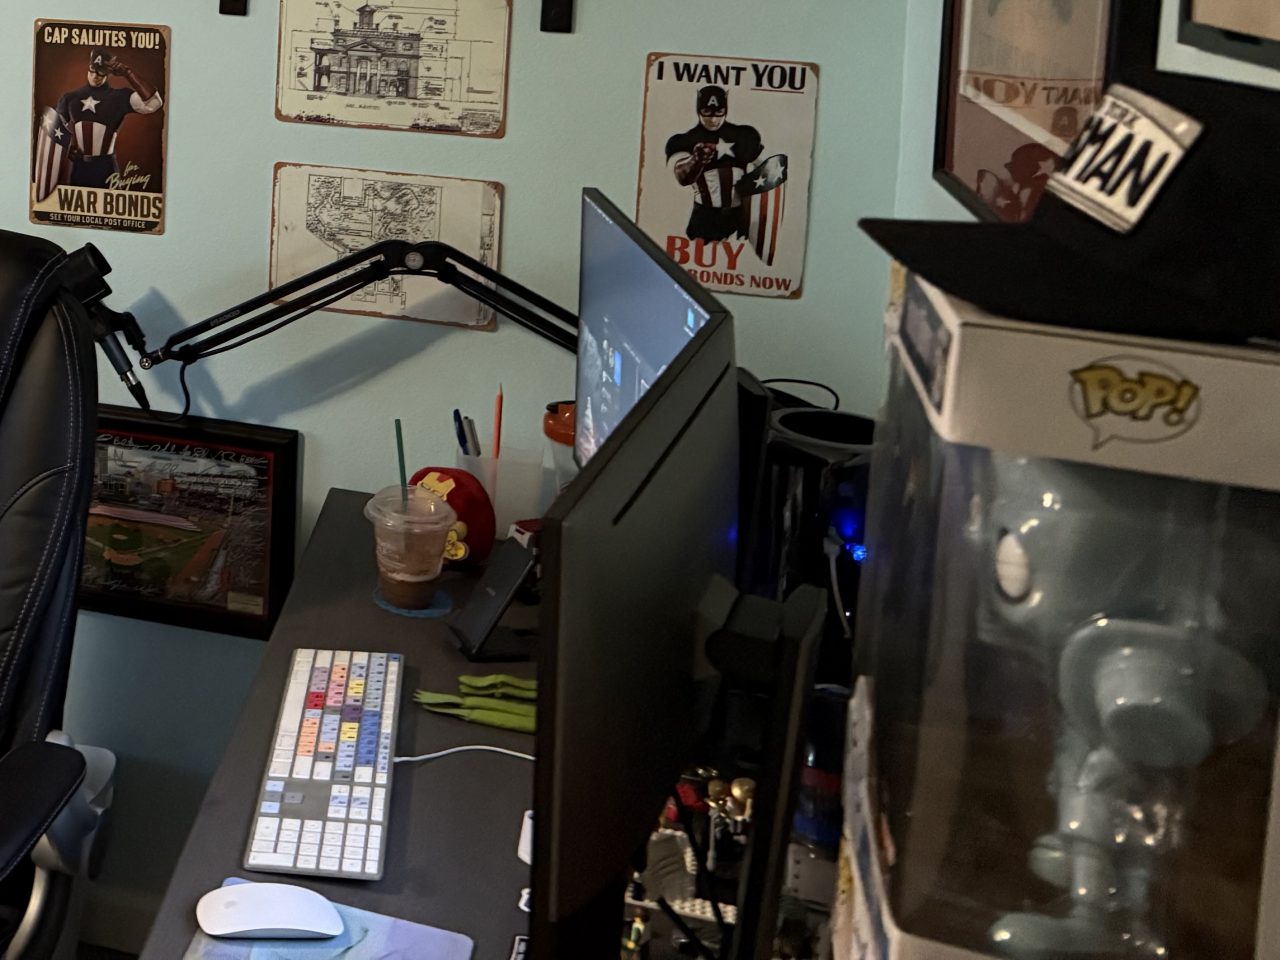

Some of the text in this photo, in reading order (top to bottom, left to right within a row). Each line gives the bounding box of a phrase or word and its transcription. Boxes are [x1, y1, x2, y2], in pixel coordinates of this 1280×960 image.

[44, 26, 160, 49] CAP SALUTES YOU!
[94, 56, 102, 66] A
[656, 61, 806, 90] I WANT YOU
[707, 95, 719, 106] A
[124, 160, 140, 175] for
[106, 172, 152, 190] Buying
[58, 188, 162, 219] WAR BONDS
[64, 214, 81, 224] YOUR
[82, 216, 102, 225] LOCAL
[104, 218, 122, 226] POST
[122, 219, 146, 228] OFFICE
[666, 235, 745, 270] BUY
[750, 274, 792, 290] NOW
[1069, 364, 1201, 426] POP!
